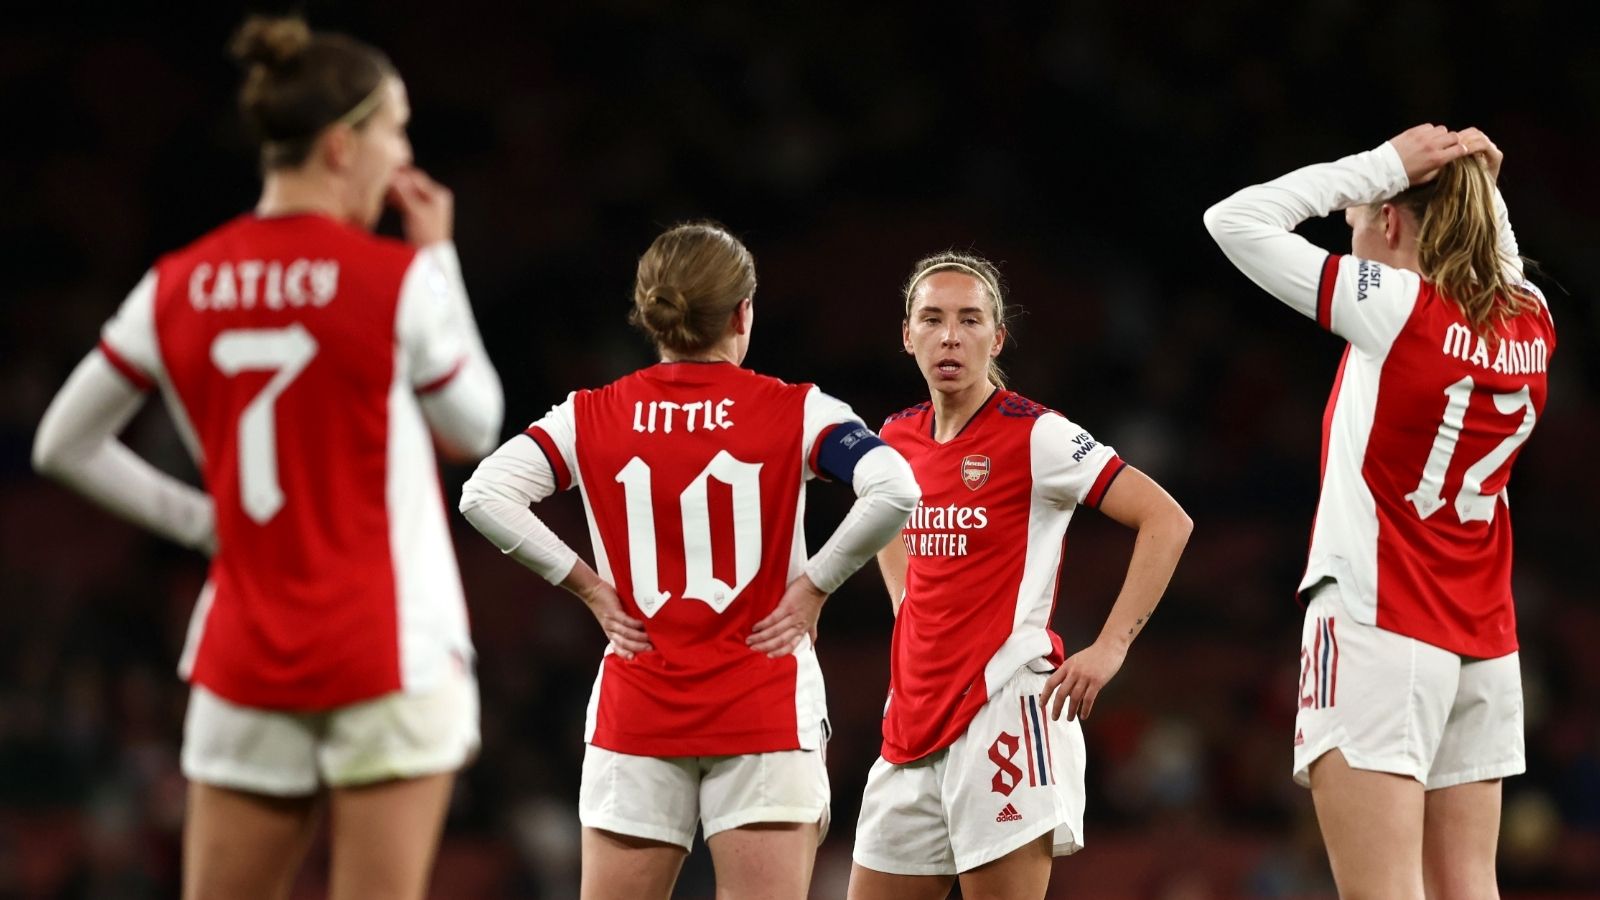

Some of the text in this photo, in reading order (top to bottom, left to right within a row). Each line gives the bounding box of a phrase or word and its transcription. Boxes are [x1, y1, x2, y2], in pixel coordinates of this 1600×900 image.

[188, 259, 340, 312] CATLEY
[1443, 321, 1548, 376] MAANUM
[210, 321, 319, 526] 7
[632, 398, 736, 434] LITTLE
[1071, 432, 1089, 445] VIS
[1404, 374, 1537, 525] 12
[614, 449, 765, 619] 10
[903, 500, 988, 530] irates
[920, 534, 968, 556] BETTER
[987, 730, 1024, 798] 8
[996, 813, 1023, 823] adidas
